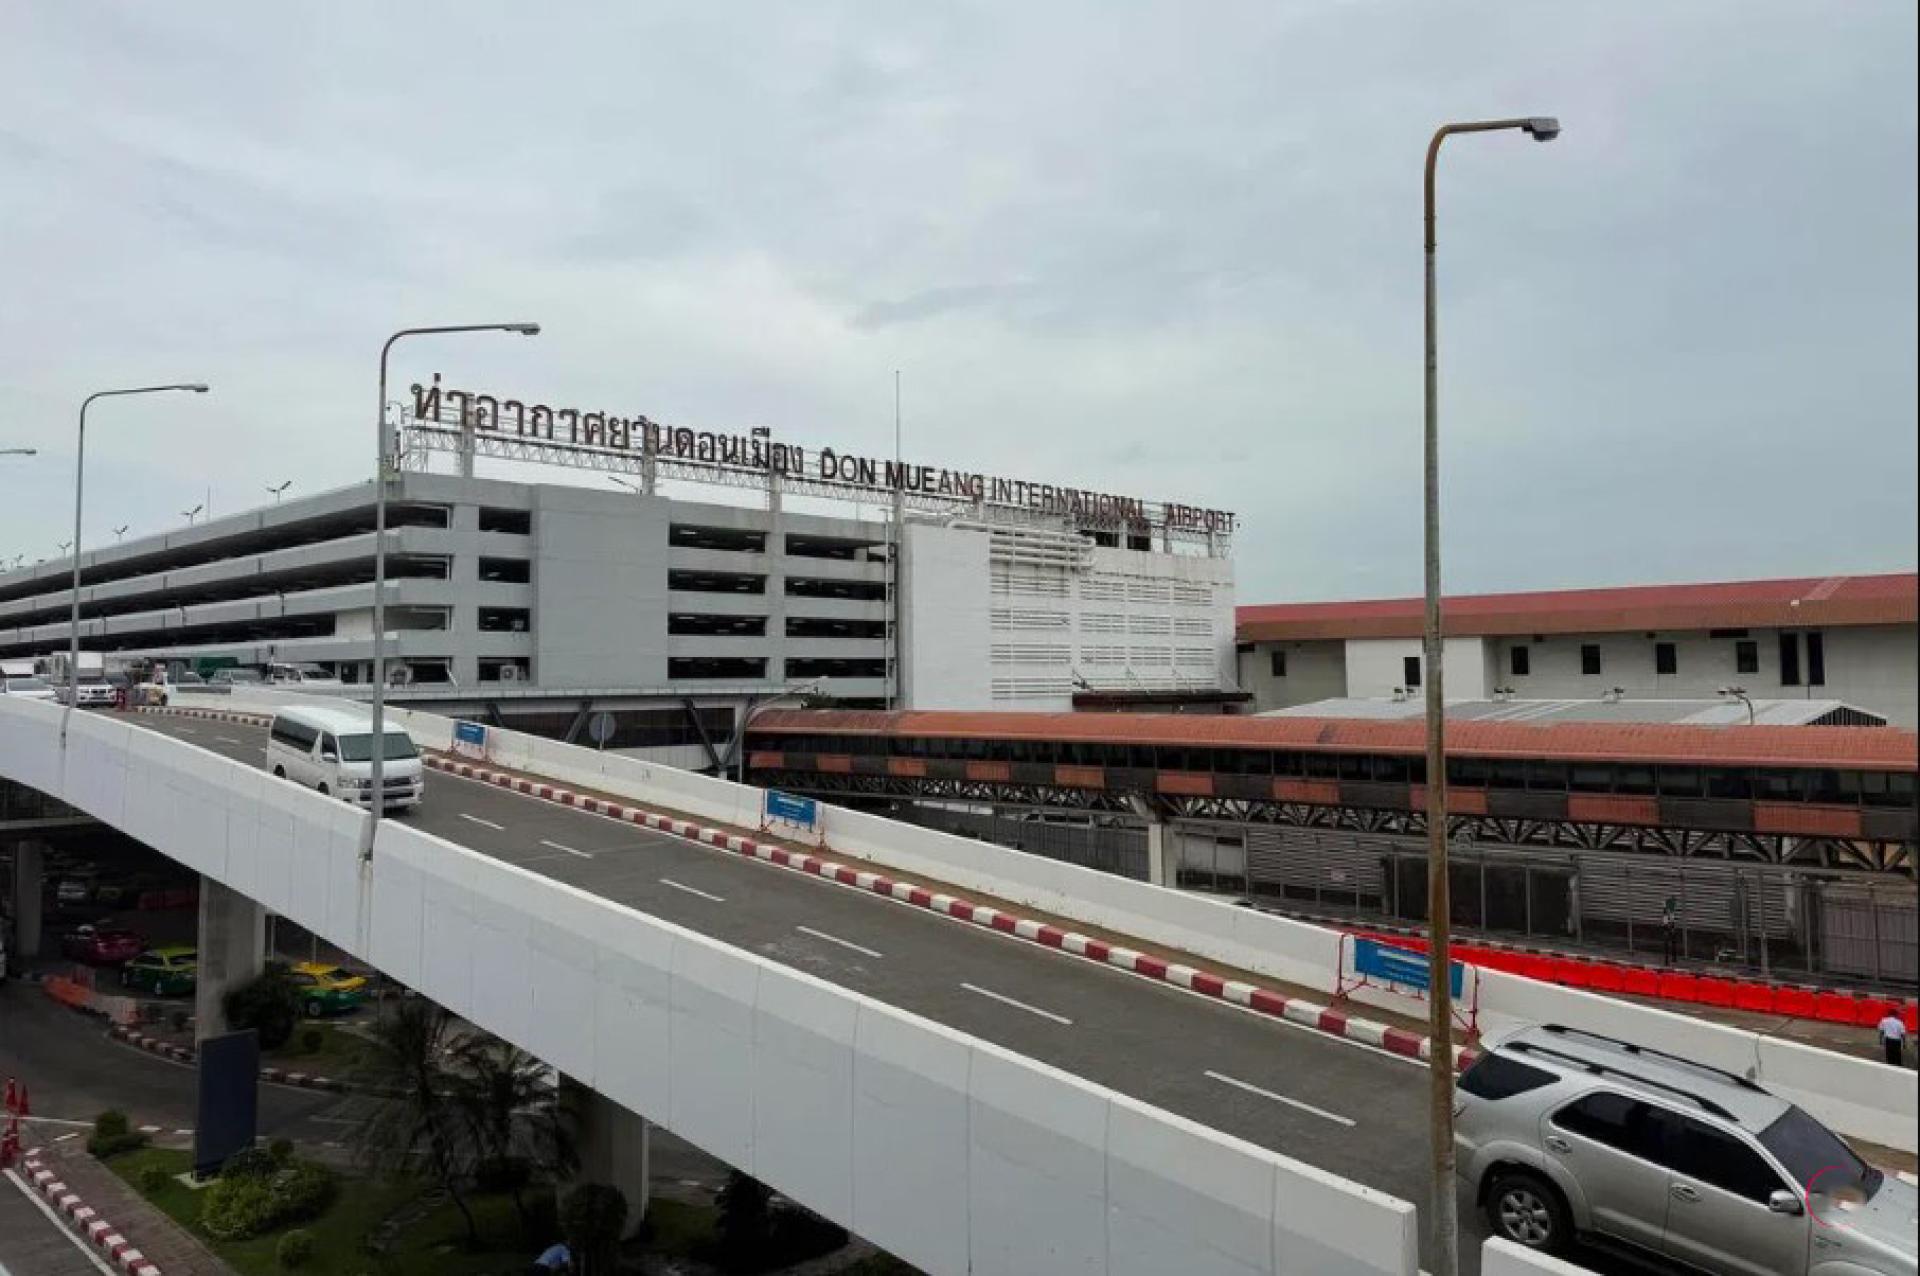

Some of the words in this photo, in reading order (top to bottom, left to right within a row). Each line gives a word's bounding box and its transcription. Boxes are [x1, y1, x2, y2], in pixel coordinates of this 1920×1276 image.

[410, 372, 804, 473] ท่าอากาศยานดอนเมือง
[820, 450, 876, 484] DON
[885, 460, 984, 500] MUEANG
[991, 476, 1145, 522] INTERNATIONAL
